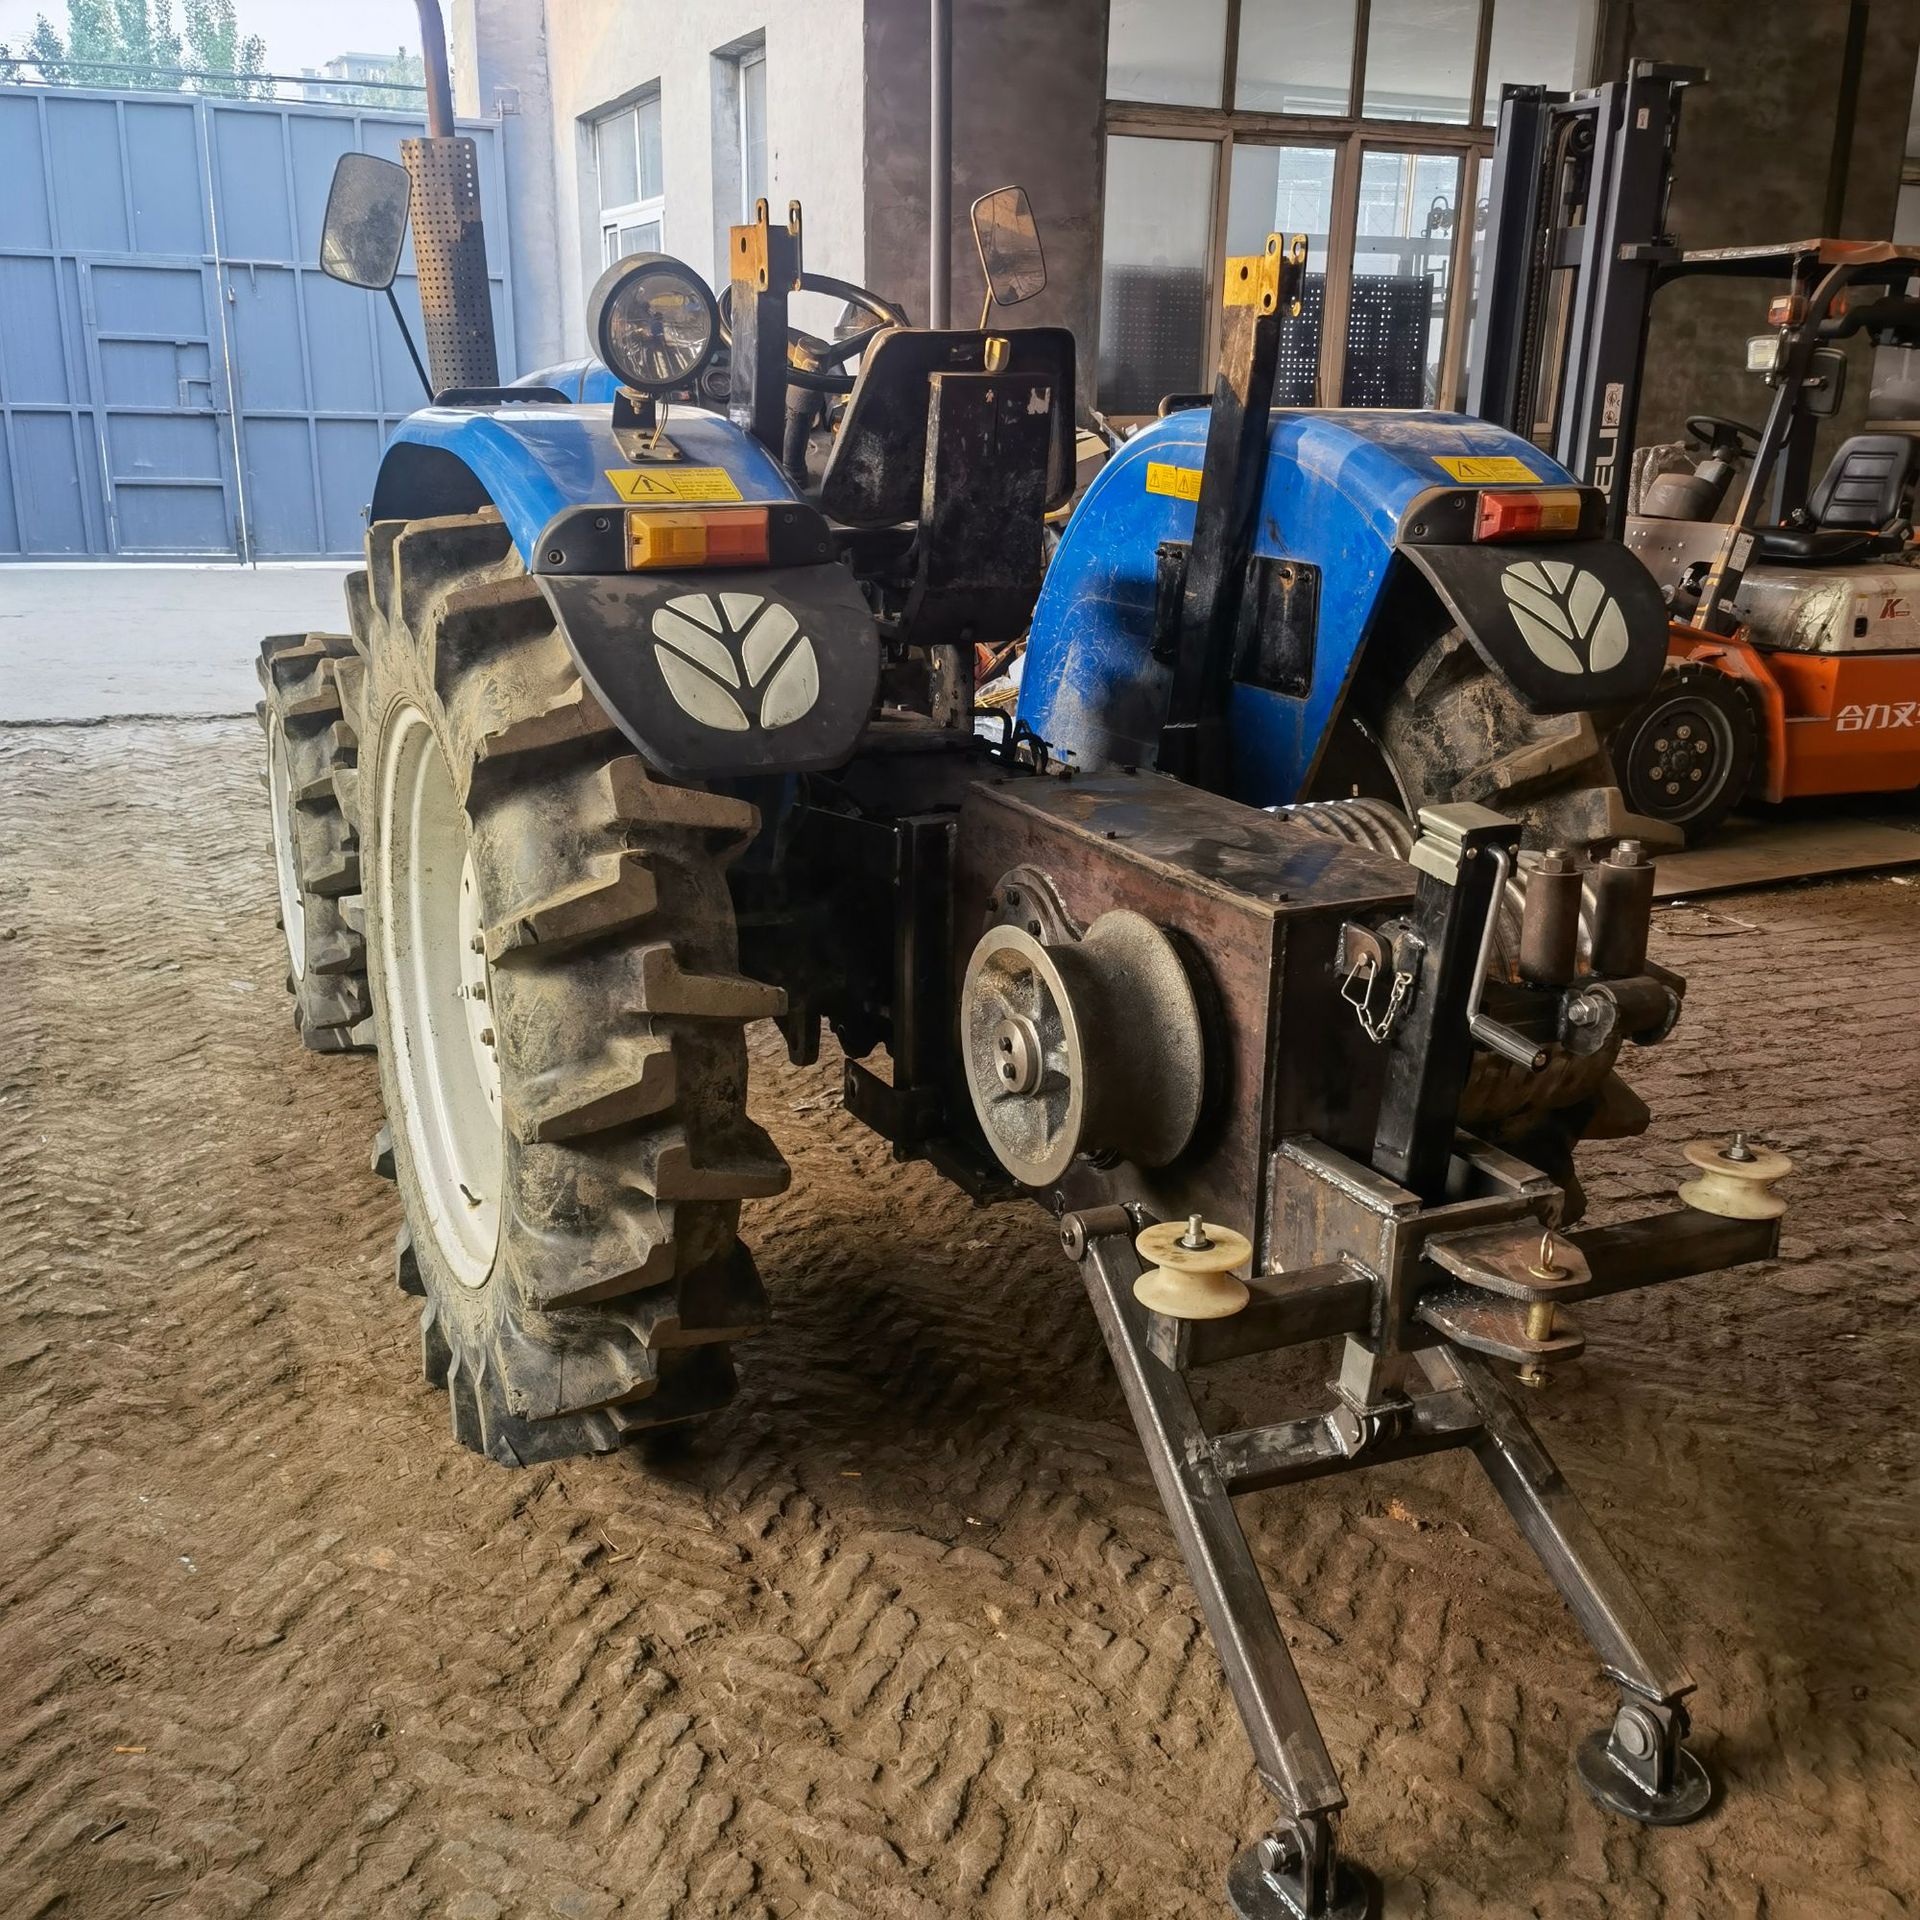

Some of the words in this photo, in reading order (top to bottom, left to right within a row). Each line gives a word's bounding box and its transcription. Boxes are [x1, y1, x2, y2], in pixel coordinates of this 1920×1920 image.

[1594, 428, 1619, 504] ELI
[1836, 702, 1920, 732] 合力叉
